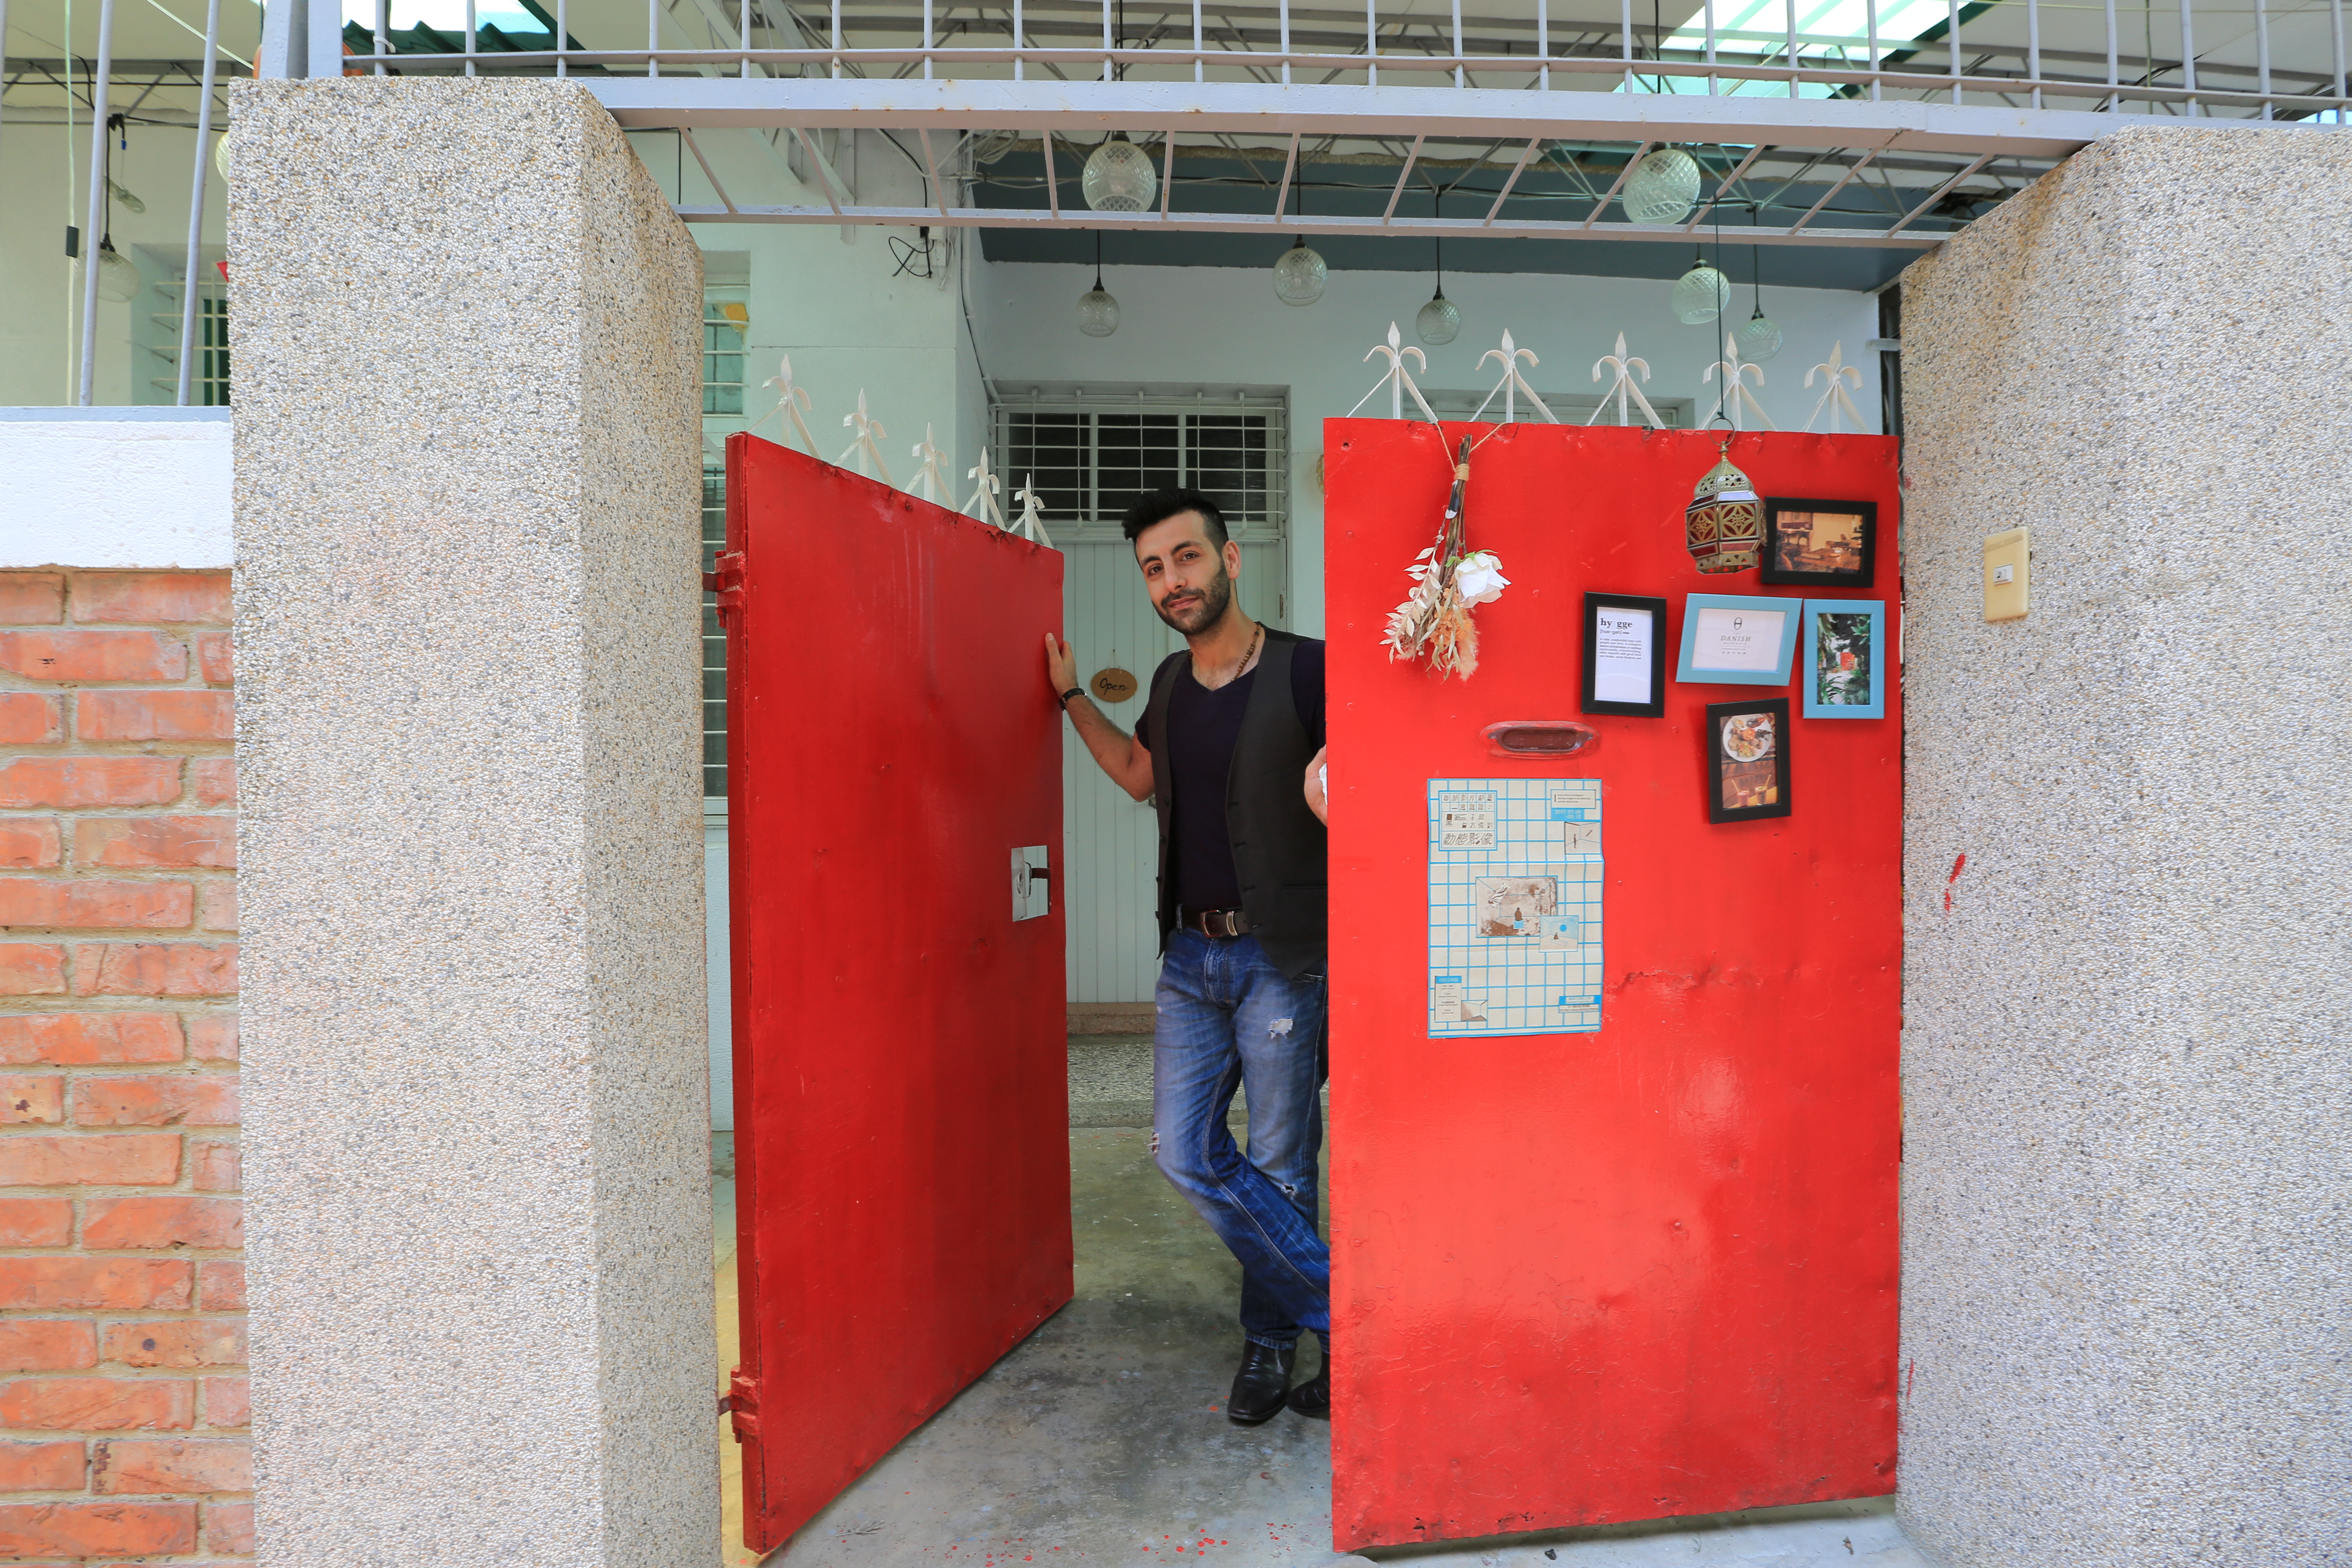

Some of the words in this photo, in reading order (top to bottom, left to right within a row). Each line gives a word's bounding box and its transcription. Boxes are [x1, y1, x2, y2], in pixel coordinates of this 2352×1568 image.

[1100, 678, 1129, 695] Open
[1443, 833, 1493, 845] 動態影像
